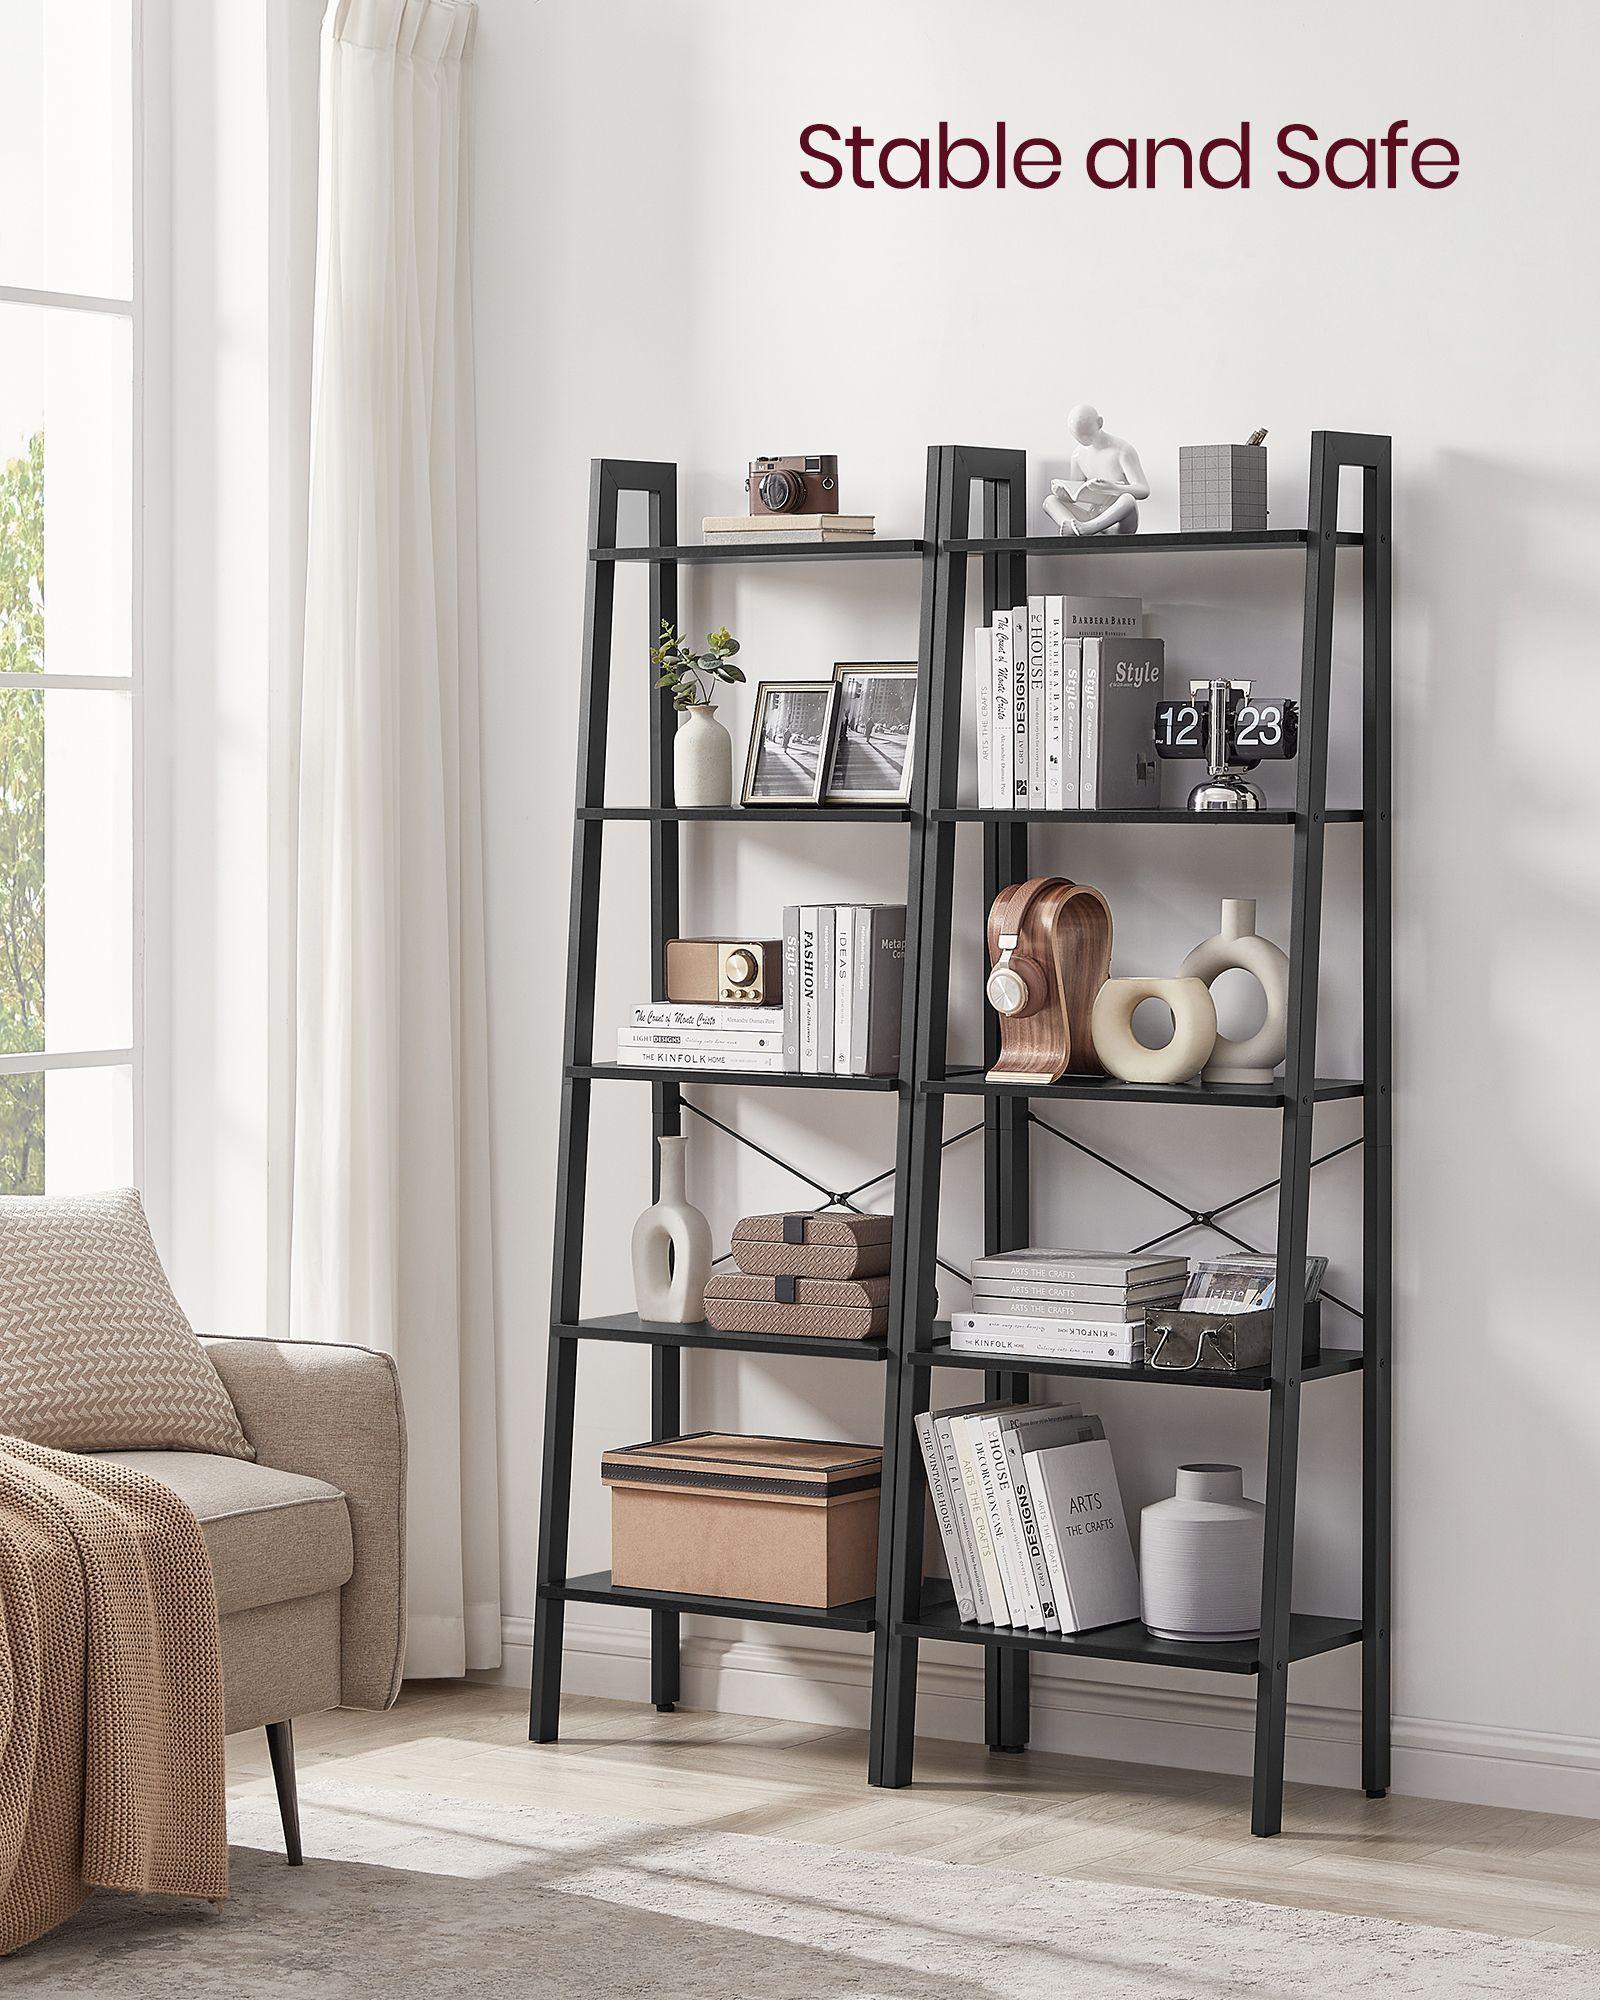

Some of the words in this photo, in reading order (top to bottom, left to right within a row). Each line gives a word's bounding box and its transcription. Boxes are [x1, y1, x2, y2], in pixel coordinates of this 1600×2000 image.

[998, 617, 1009, 630] The
[1031, 614, 1042, 623] PC
[996, 632, 1009, 654] Count
[1031, 628, 1043, 690] HOUSE
[998, 667, 1009, 693] Monte
[1116, 661, 1159, 688] Style
[1016, 661, 1025, 734] DESIGNS
[1066, 668, 1078, 710] Style
[1085, 668, 1097, 710] Style
[996, 696, 1008, 720] Cristo
[1160, 707, 1199, 745] 12
[1237, 707, 1282, 745] 23
[786, 935, 797, 976] Style
[804, 930, 814, 1000] FASHION
[839, 932, 847, 979] IDEAS
[635, 1010, 646, 1022] The
[647, 1010, 664, 1024] Count
[665, 1012, 671, 1026] of
[674, 1011, 695, 1024] Monte
[696, 1012, 716, 1027] Cristo
[653, 1035, 681, 1044] DESIGNS
[642, 1053, 654, 1061] THE
[657, 1053, 706, 1064] KINFOLK
[707, 1056, 726, 1064] HOME
[1011, 1267, 1029, 1276] ARTS
[1031, 1268, 1046, 1277] THE
[1048, 1269, 1076, 1279] CRAFTS
[1011, 1285, 1029, 1294] ARTS
[1031, 1288, 1046, 1296] THE
[1048, 1288, 1075, 1298] CRAFTS
[1010, 1304, 1028, 1312] ARTS
[1031, 1305, 1045, 1313] THE
[1047, 1306, 1074, 1315] CRAFTS
[974, 1339, 1013, 1349] KINFOLK
[1069, 1328, 1108, 1337] KINFOLK
[941, 1433, 961, 1493] CEREAL
[963, 1460, 976, 1487] ARTS
[990, 1439, 1010, 1491] HOUSE
[922, 1429, 934, 1451] THE
[929, 1453, 945, 1499] VINTAGE
[938, 1499, 953, 1536] HOUSE
[975, 1442, 998, 1512] DECORATION
[991, 1513, 1004, 1540] CASE
[969, 1489, 981, 1512] THE
[1037, 1500, 1048, 1521] ARTS
[1070, 1492, 1102, 1515] ARTS
[1017, 1484, 1041, 1558] DESIGNS
[1043, 1522, 1053, 1540] THE
[1066, 1524, 1084, 1537] THE
[1085, 1518, 1114, 1534] CRAFTS
[975, 1517, 991, 1557] CRAFTS
[1047, 1543, 1059, 1574] CRAFTS
[1036, 1561, 1046, 1587] GREAT
